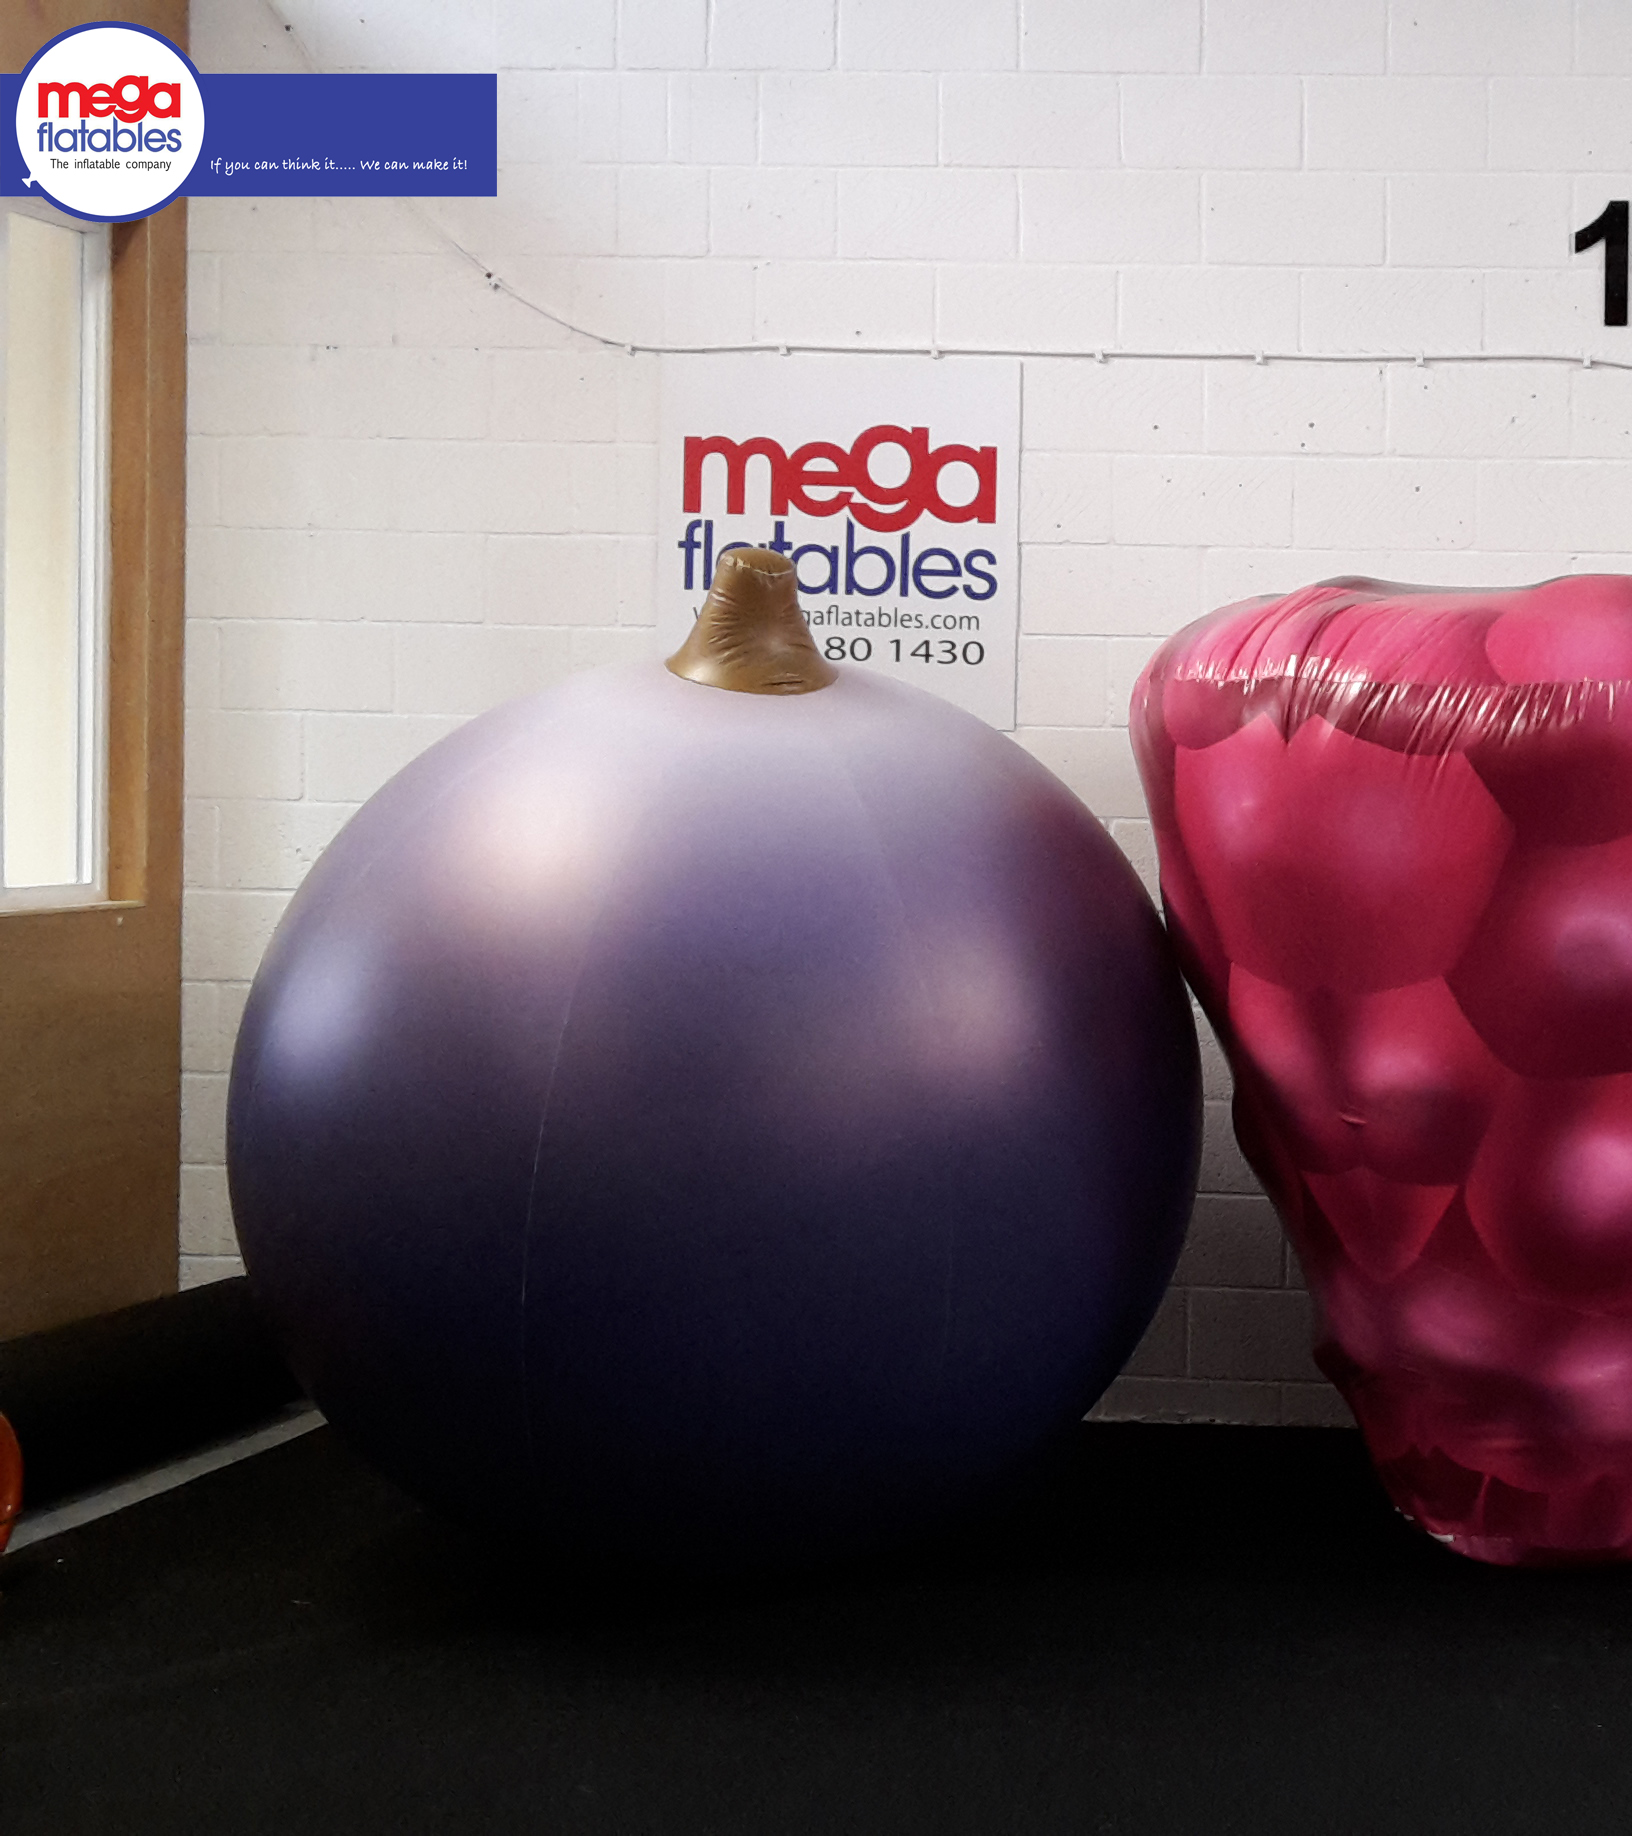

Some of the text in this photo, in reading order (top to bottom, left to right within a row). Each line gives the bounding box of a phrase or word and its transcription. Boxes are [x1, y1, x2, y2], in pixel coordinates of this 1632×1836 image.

[682, 424, 998, 533] mega
[678, 517, 998, 601] fltables
[824, 635, 985, 666] 80 1430
